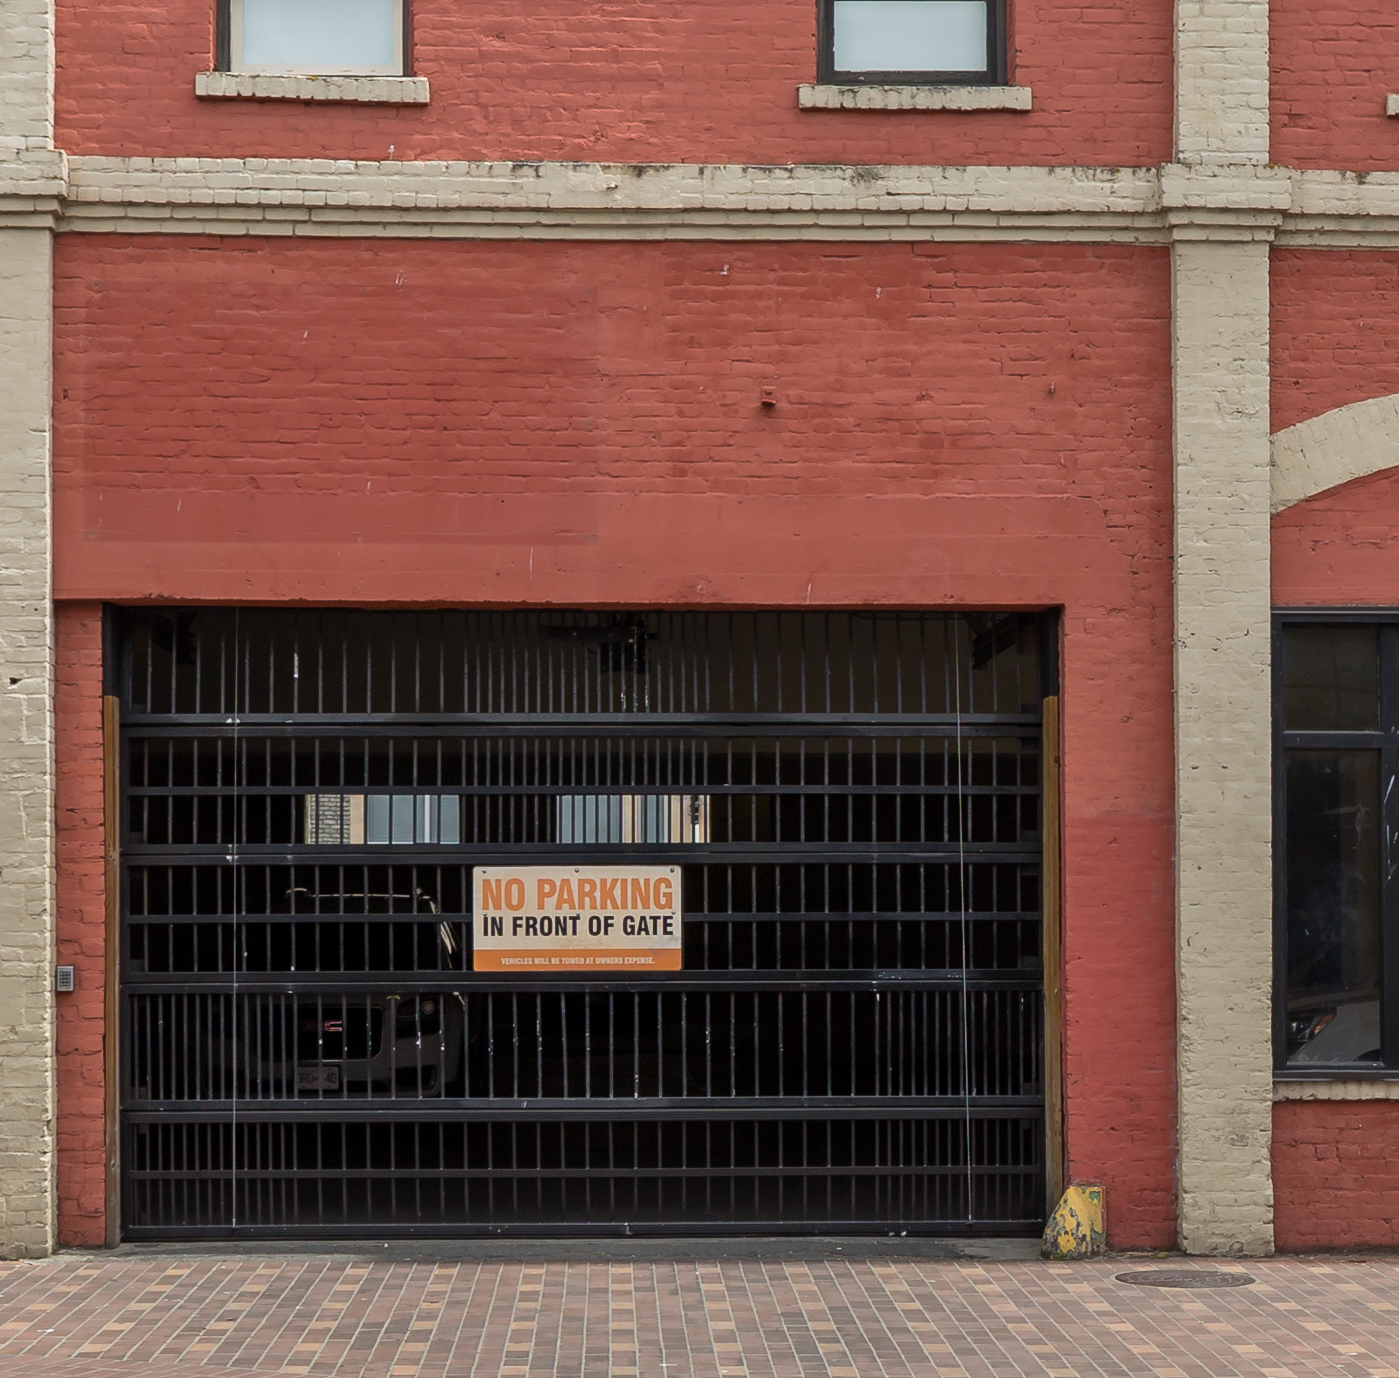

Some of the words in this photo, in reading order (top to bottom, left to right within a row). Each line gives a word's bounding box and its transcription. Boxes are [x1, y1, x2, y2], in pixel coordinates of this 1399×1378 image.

[482, 878, 526, 911] NO
[537, 877, 673, 911] PARKING
[483, 916, 504, 937] IN
[512, 916, 581, 937] FRONT
[588, 915, 615, 936] OF
[622, 915, 674, 936] GATE
[501, 957, 533, 965] VEHICLES
[534, 957, 550, 965] WILL
[551, 957, 560, 965] BE
[561, 957, 585, 965] TOWED
